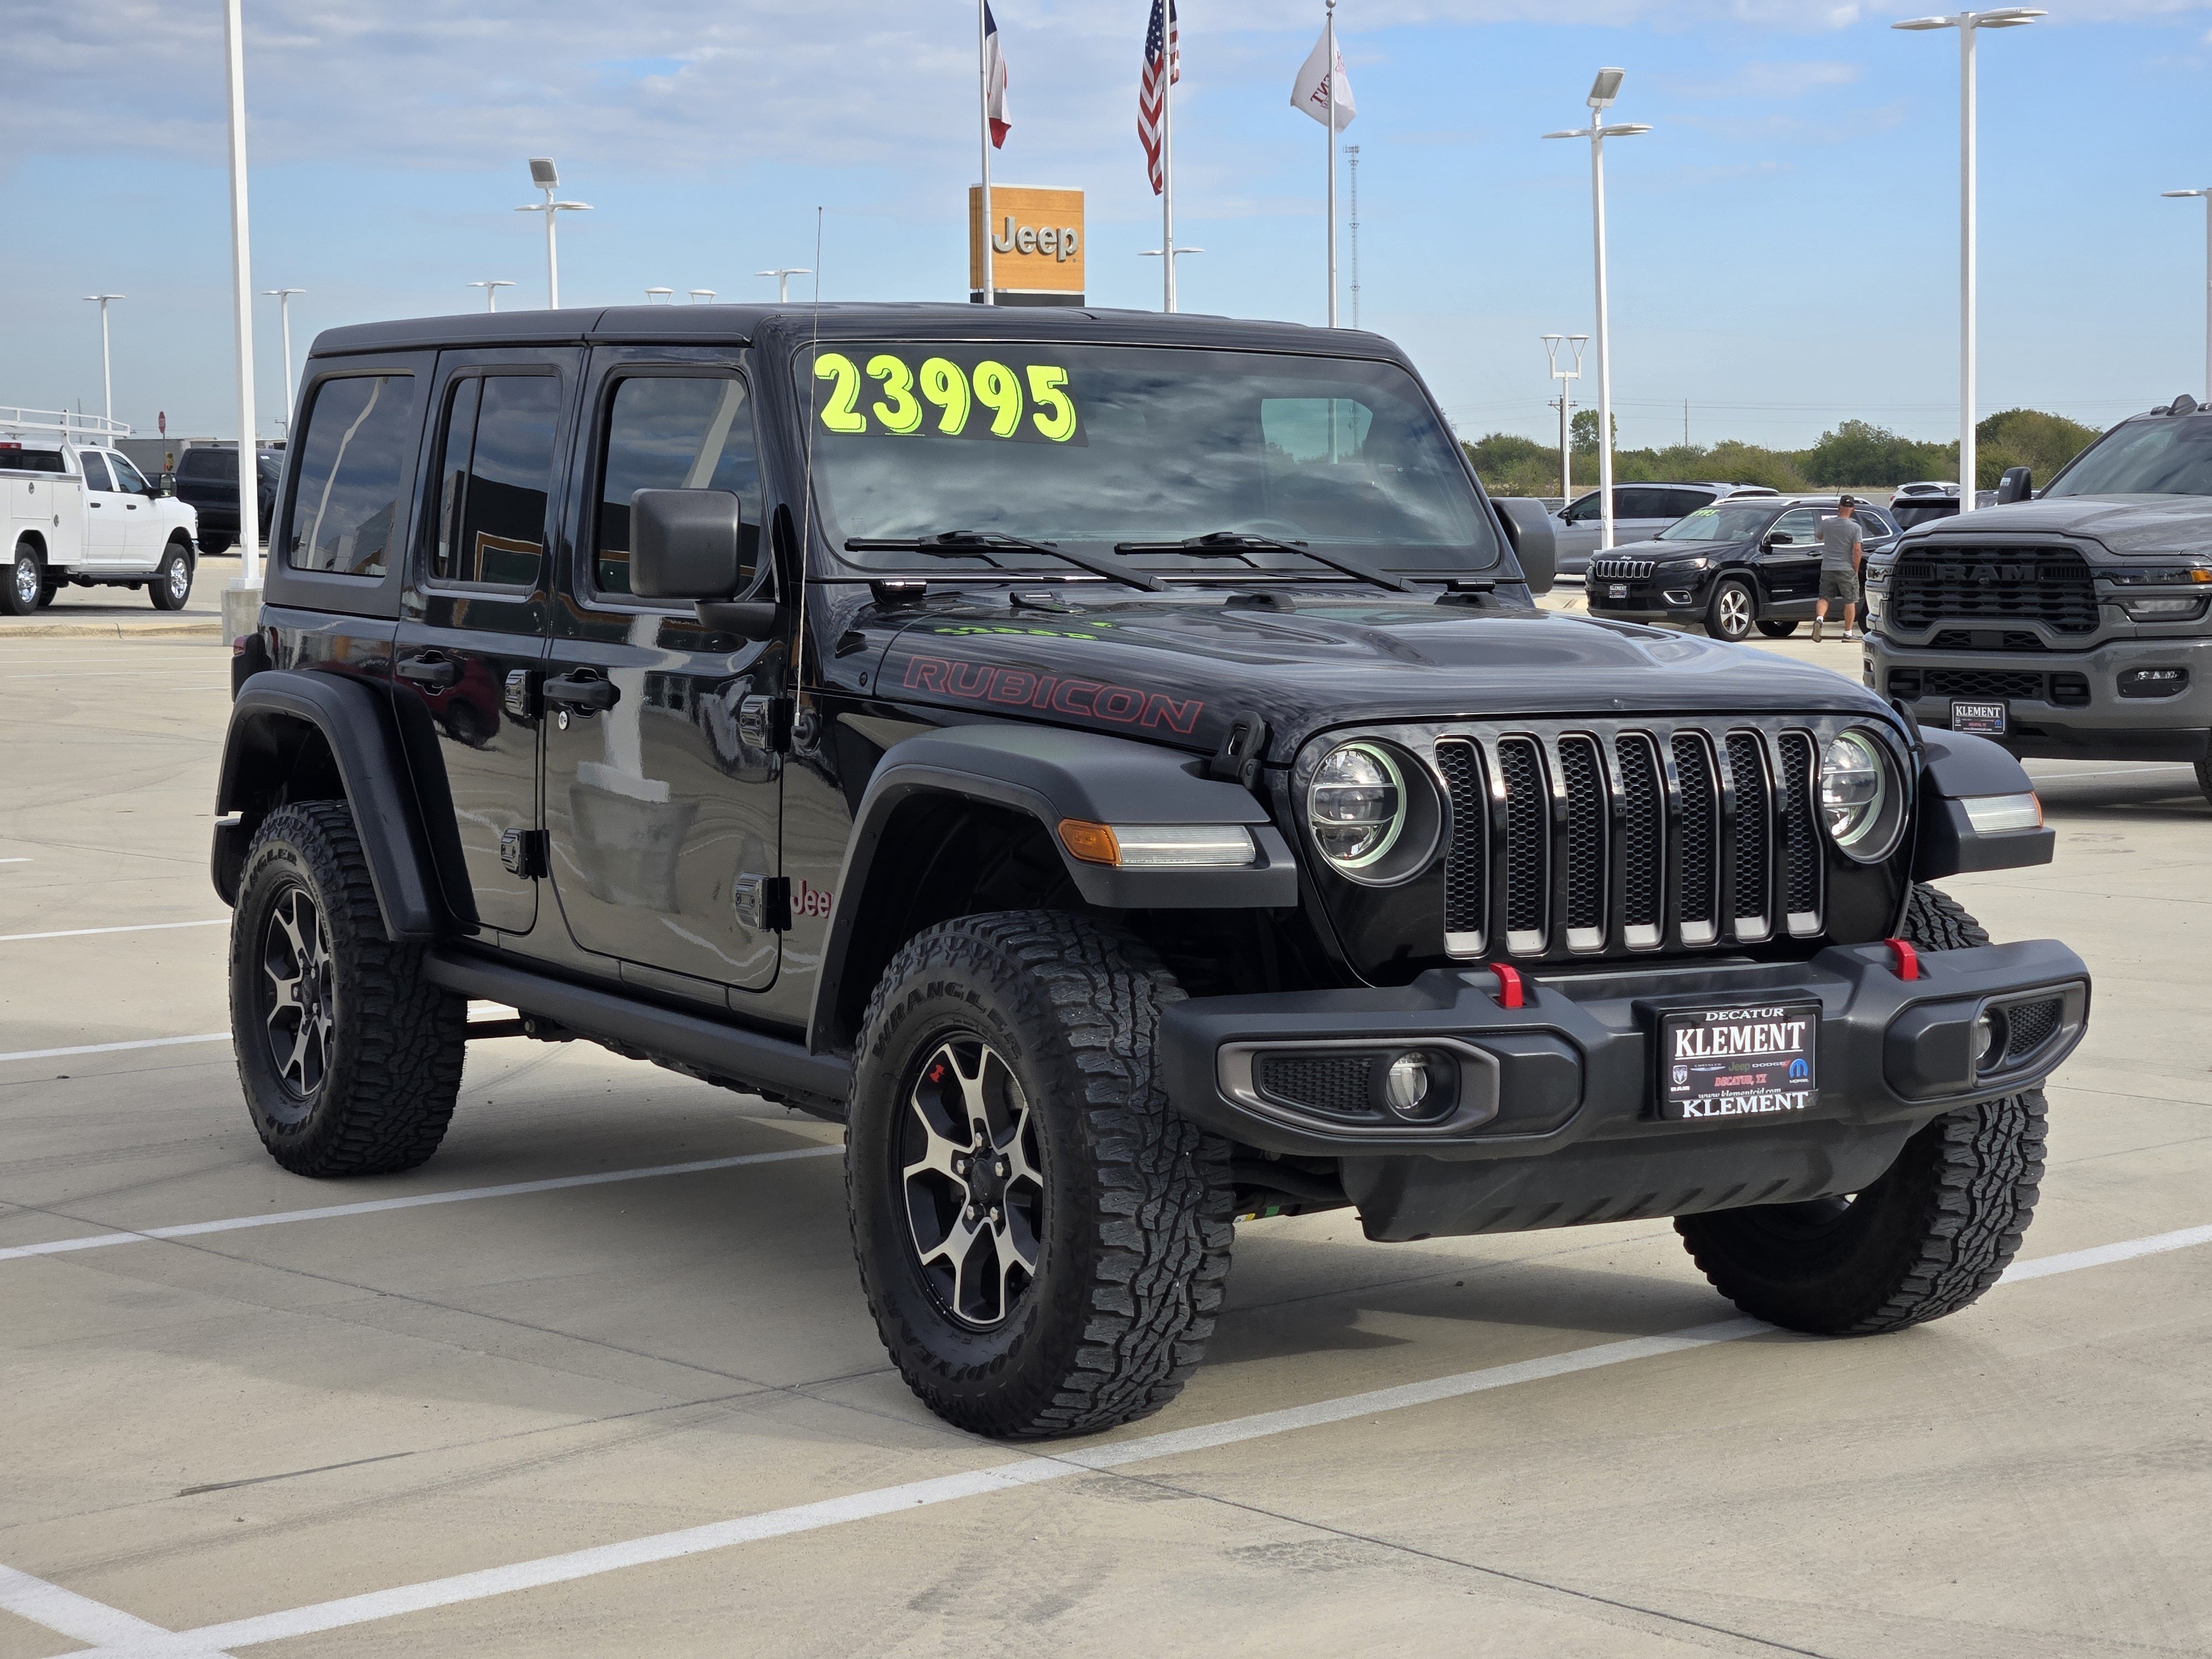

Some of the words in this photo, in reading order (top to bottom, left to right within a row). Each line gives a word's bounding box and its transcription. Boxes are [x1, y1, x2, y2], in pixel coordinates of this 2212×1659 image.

[992, 216, 1078, 263] Jeep
[813, 353, 1076, 442] 23995
[1937, 564, 2035, 582] RAM
[903, 655, 1204, 734] RUBICON
[1955, 706, 2001, 717] KLEMENT
[790, 879, 834, 919] Jee
[872, 980, 1022, 1061] WRANGLER
[1705, 1008, 1784, 1021] DECATUR
[1674, 1021, 1806, 1057] KLEMENT
[1728, 1062, 1750, 1073] Jeep
[1682, 1091, 1808, 1118] KLEMENT
